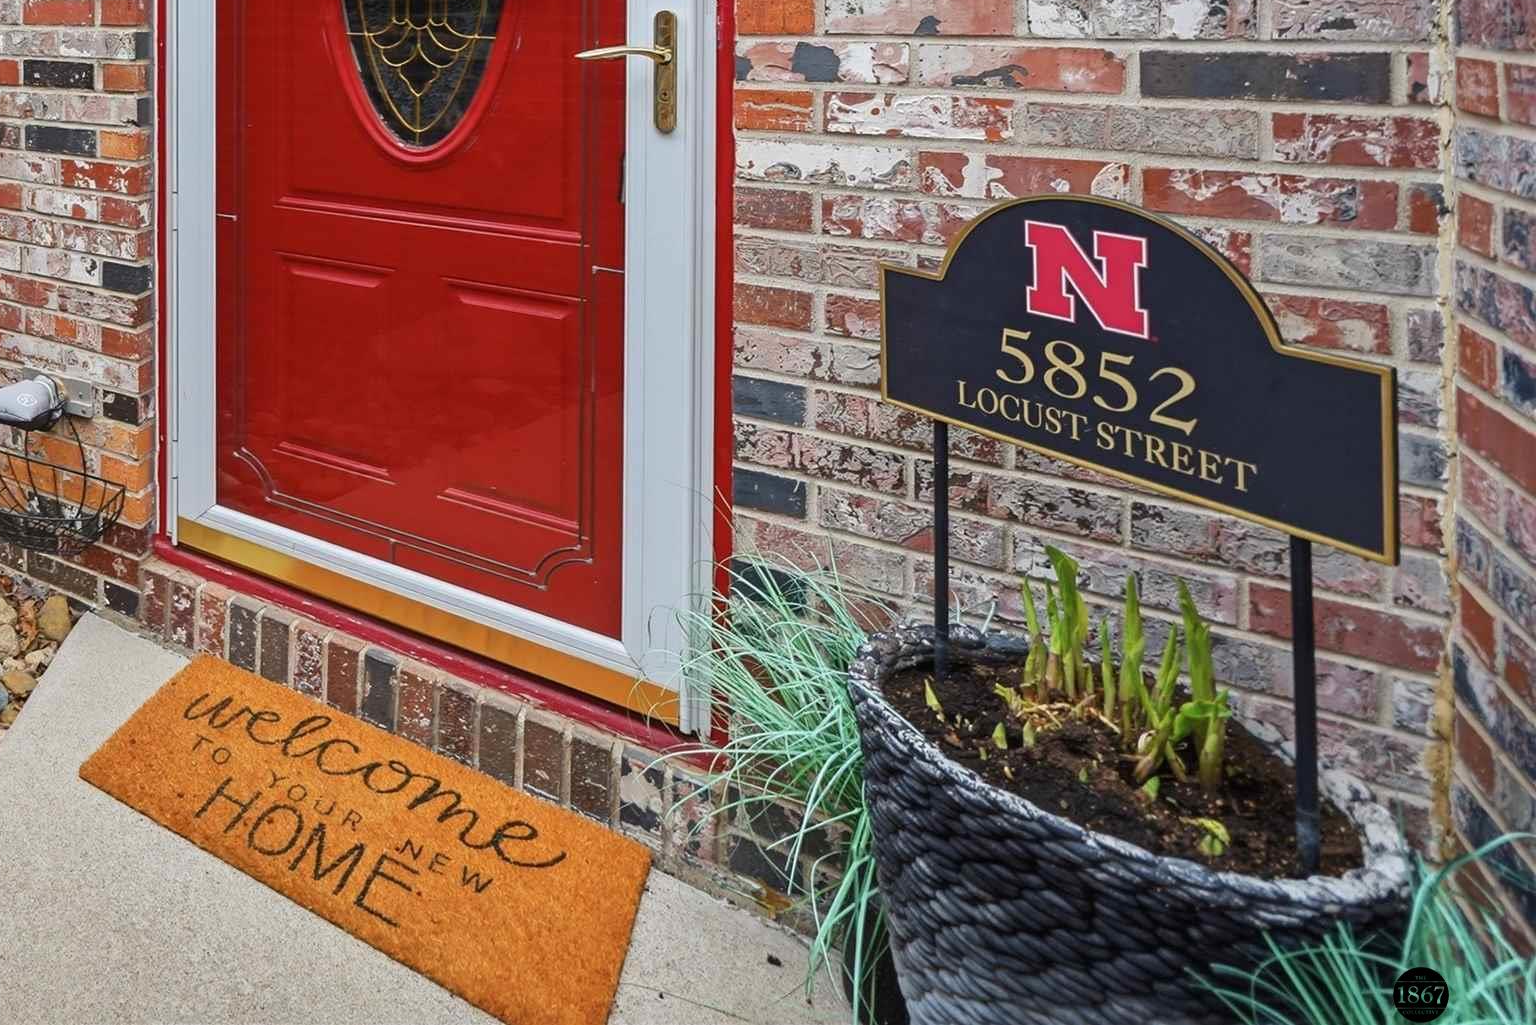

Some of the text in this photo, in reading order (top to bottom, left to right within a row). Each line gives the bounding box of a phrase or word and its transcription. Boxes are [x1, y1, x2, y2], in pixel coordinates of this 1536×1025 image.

[1024, 219, 1149, 340] N
[956, 379, 1258, 493] LOCUST STREET
[995, 327, 1199, 437] 5852
[183, 692, 568, 869] welcome
[192, 734, 494, 894] TO YOUR NEW
[193, 777, 421, 928] HOME
